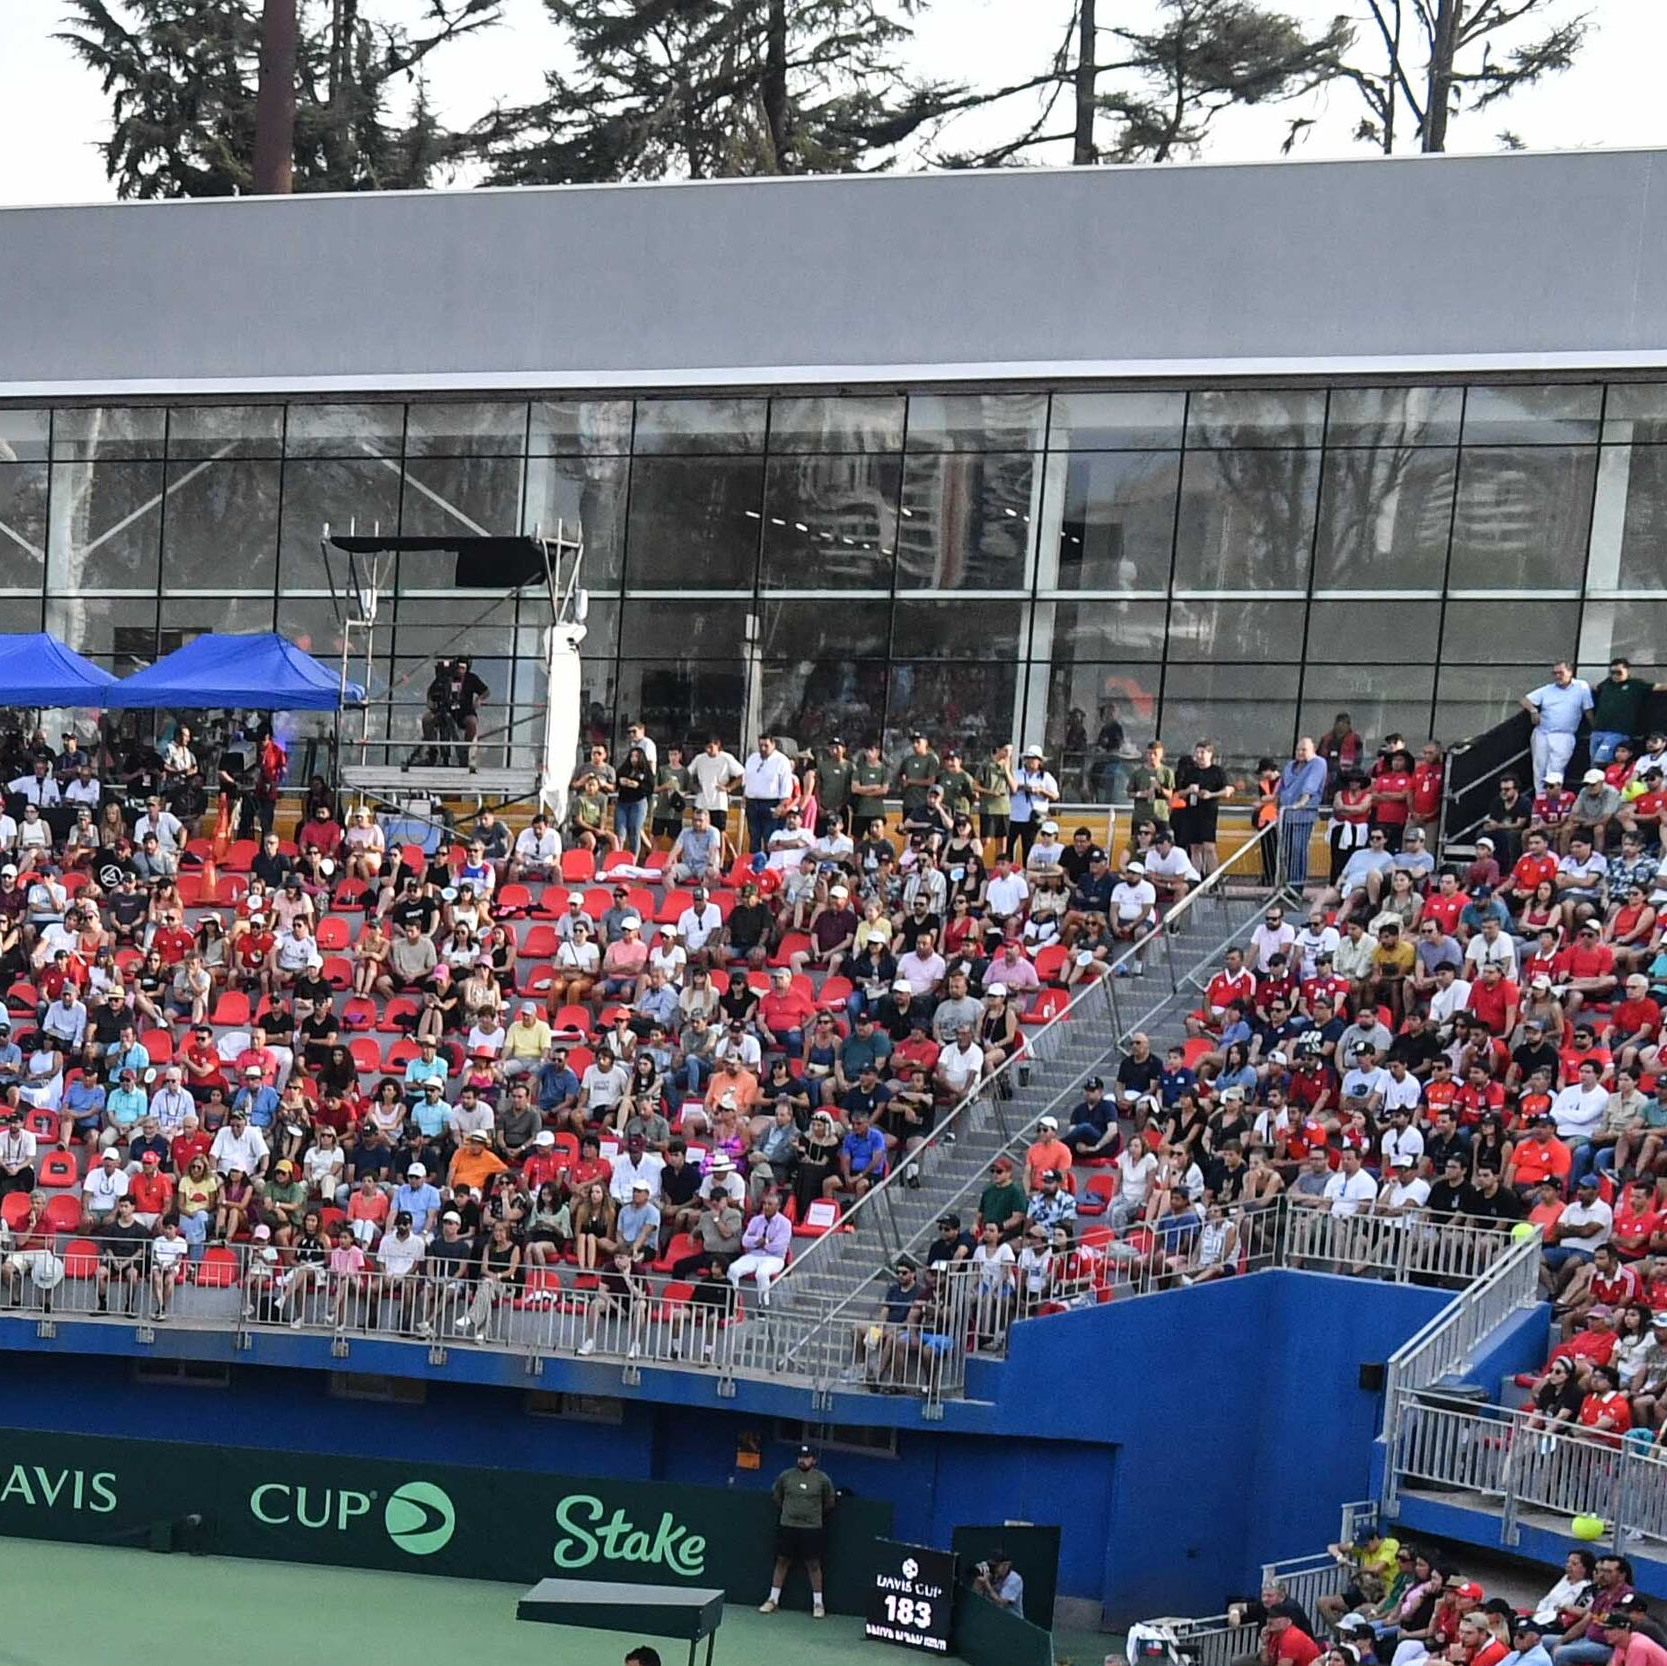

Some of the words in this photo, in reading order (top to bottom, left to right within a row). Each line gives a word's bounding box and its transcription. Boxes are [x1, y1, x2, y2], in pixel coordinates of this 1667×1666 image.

[553, 1494, 706, 1576] Stake
[877, 1574, 912, 1592] DAVIS
[884, 1595, 931, 1629] 183
